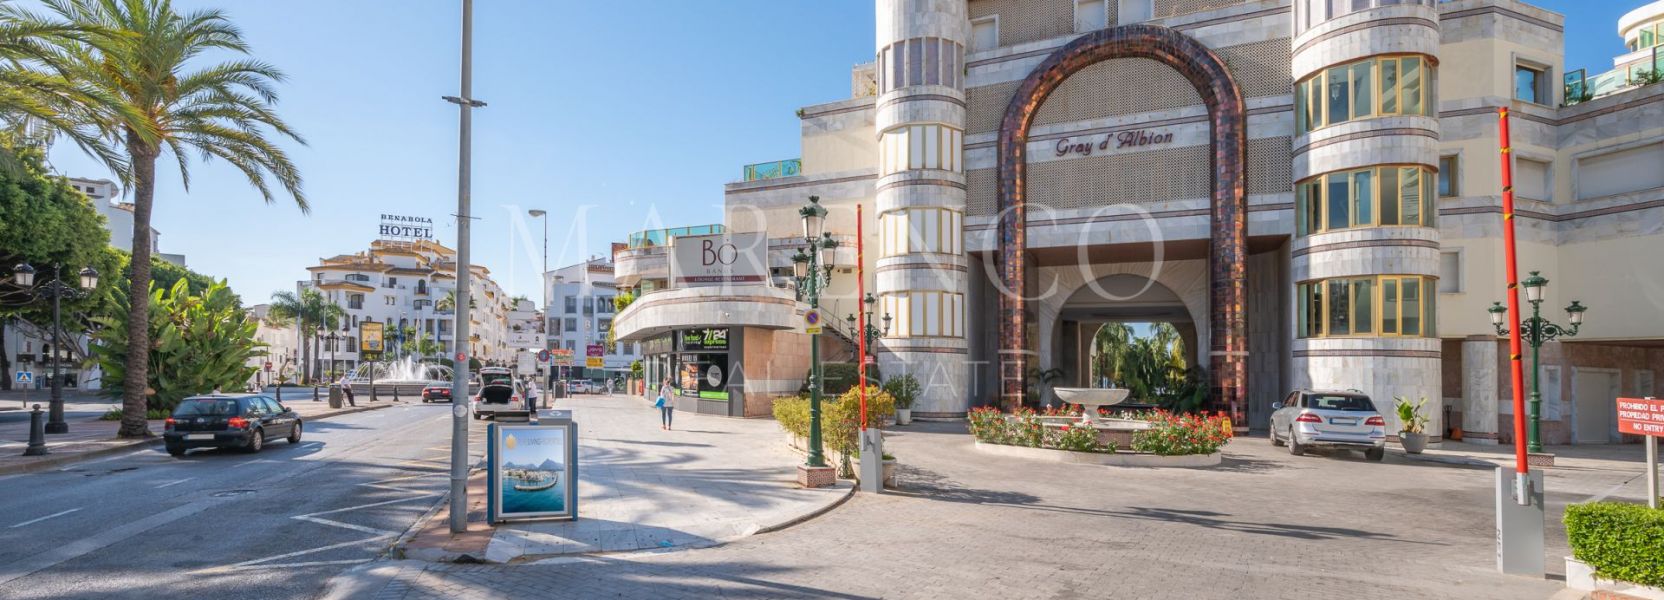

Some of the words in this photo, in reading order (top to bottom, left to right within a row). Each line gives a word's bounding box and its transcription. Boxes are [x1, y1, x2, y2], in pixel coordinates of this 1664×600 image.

[1056, 138, 1093, 156] Gray
[1116, 130, 1173, 149] Albion
[381, 214, 432, 223] BENABOLA
[379, 225, 433, 238] HOTEL
[1619, 411, 1650, 419] PROPIEDAD
[1643, 424, 1664, 432] ENTRY
